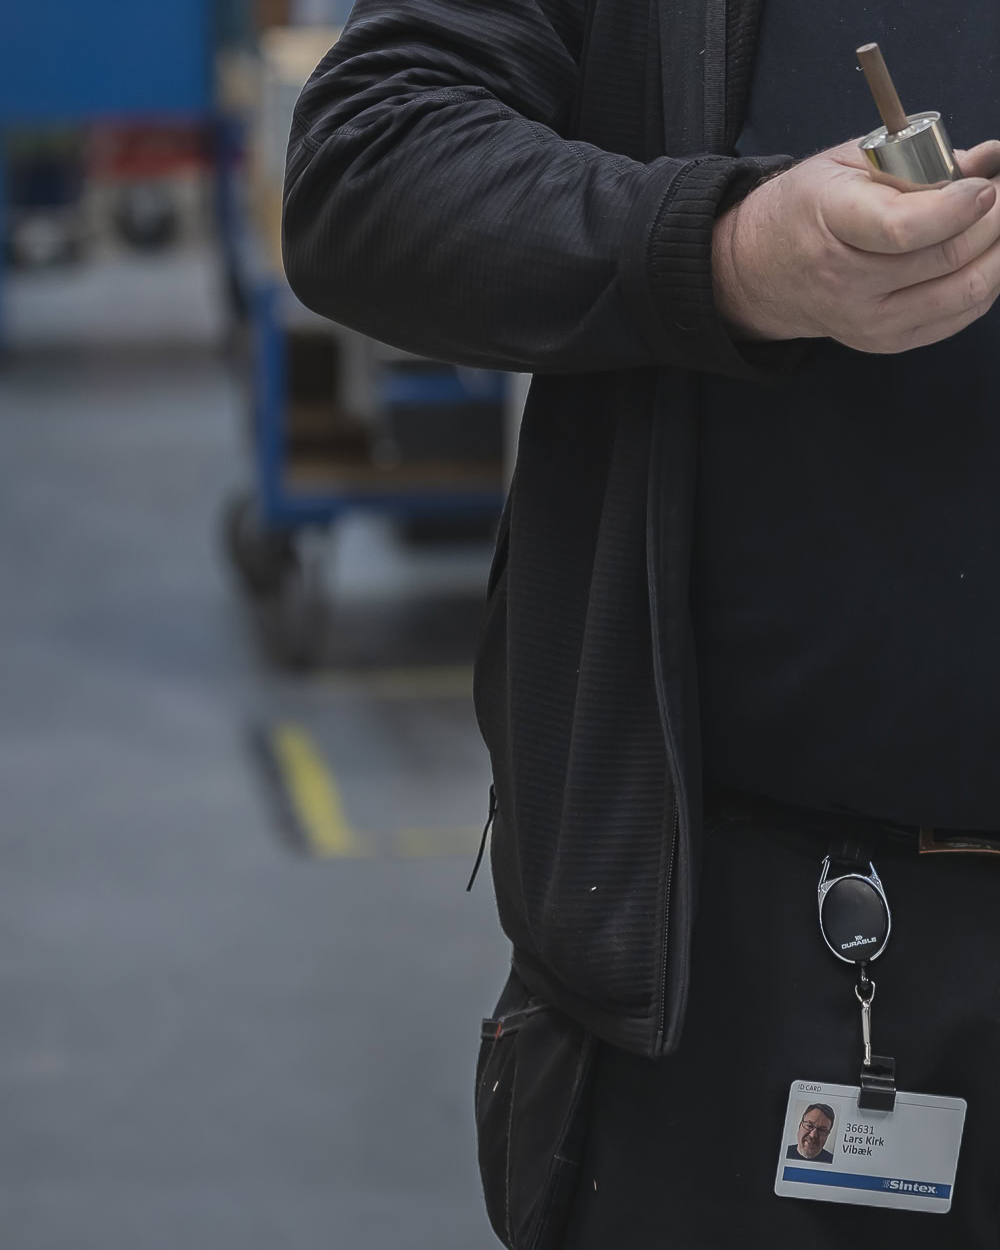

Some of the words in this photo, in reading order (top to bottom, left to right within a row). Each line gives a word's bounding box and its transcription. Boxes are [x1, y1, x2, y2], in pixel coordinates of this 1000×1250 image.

[841, 937, 877, 949] DURABLE
[805, 1084, 822, 1092] CARD
[845, 1123, 875, 1135] 36631
[844, 1134, 863, 1144] Lars
[866, 1136, 885, 1146] Kirk
[842, 1144, 873, 1157] Vibæk
[889, 1180, 936, 1194] Sintex
